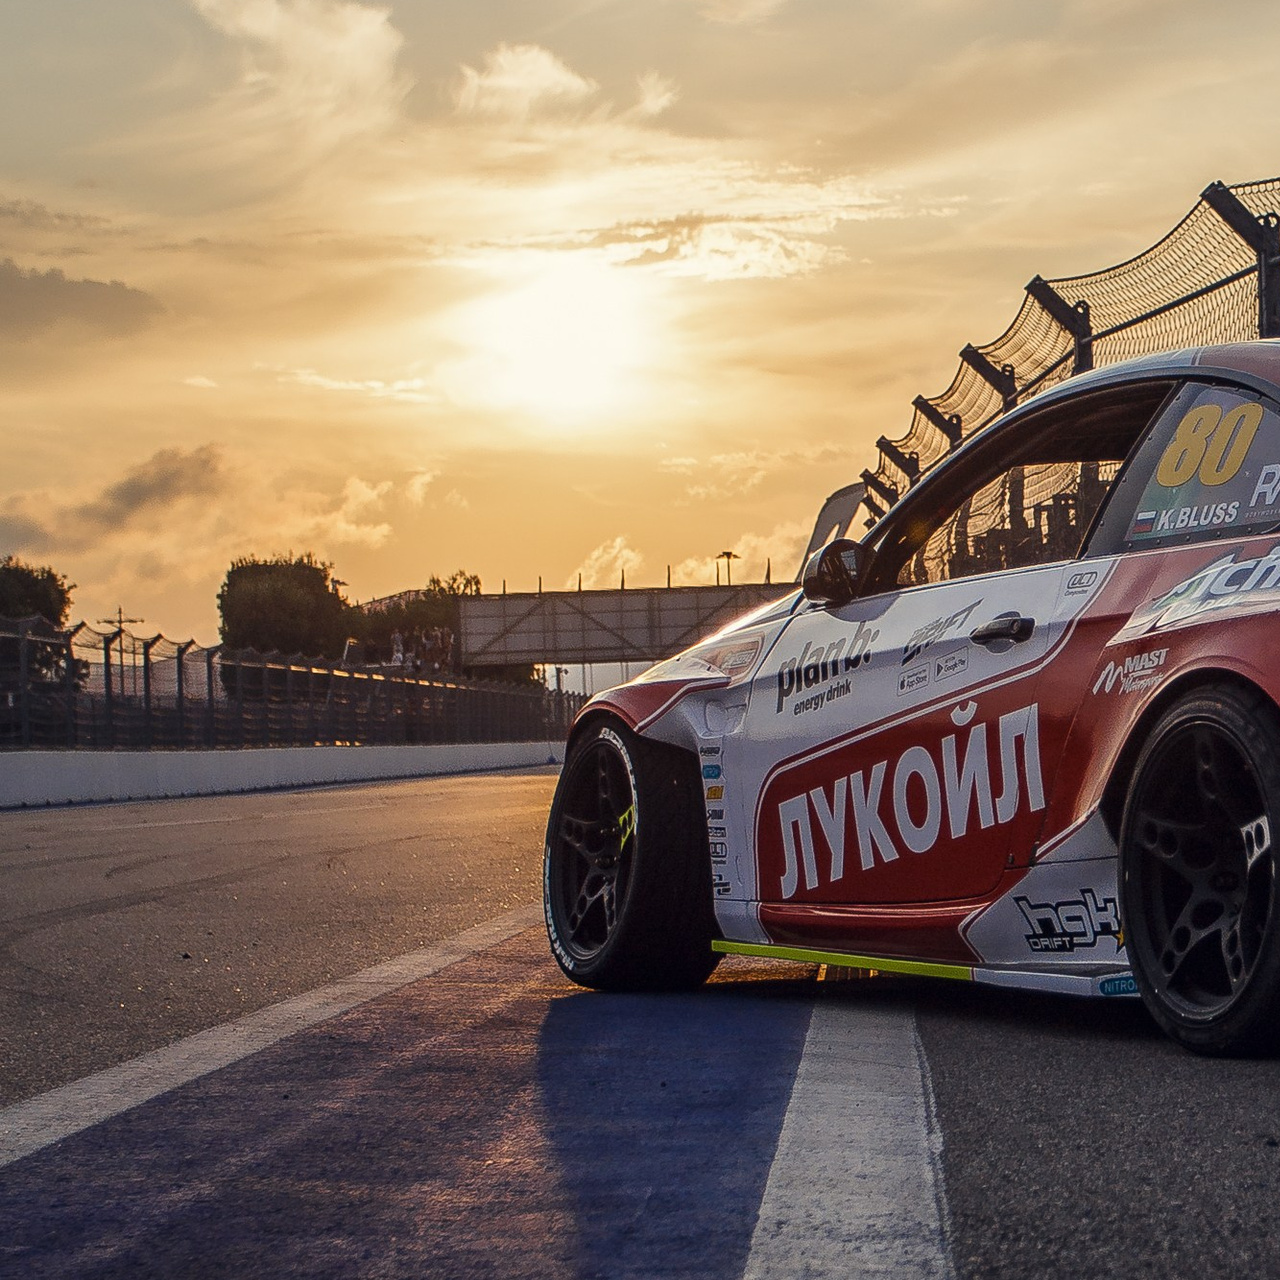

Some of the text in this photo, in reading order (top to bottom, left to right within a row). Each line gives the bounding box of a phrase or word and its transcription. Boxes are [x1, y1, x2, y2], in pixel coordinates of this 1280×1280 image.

[1156, 403, 1264, 487] 80
[1157, 501, 1240, 531] K.BLUSS
[777, 636, 846, 714] plan
[1124, 648, 1170, 673] MAST
[794, 677, 852, 716] energy drink
[778, 700, 1046, 900] ЛУКОЙЛ
[1029, 936, 1071, 950] DRIFT
[1104, 979, 1138, 993] NITRO
